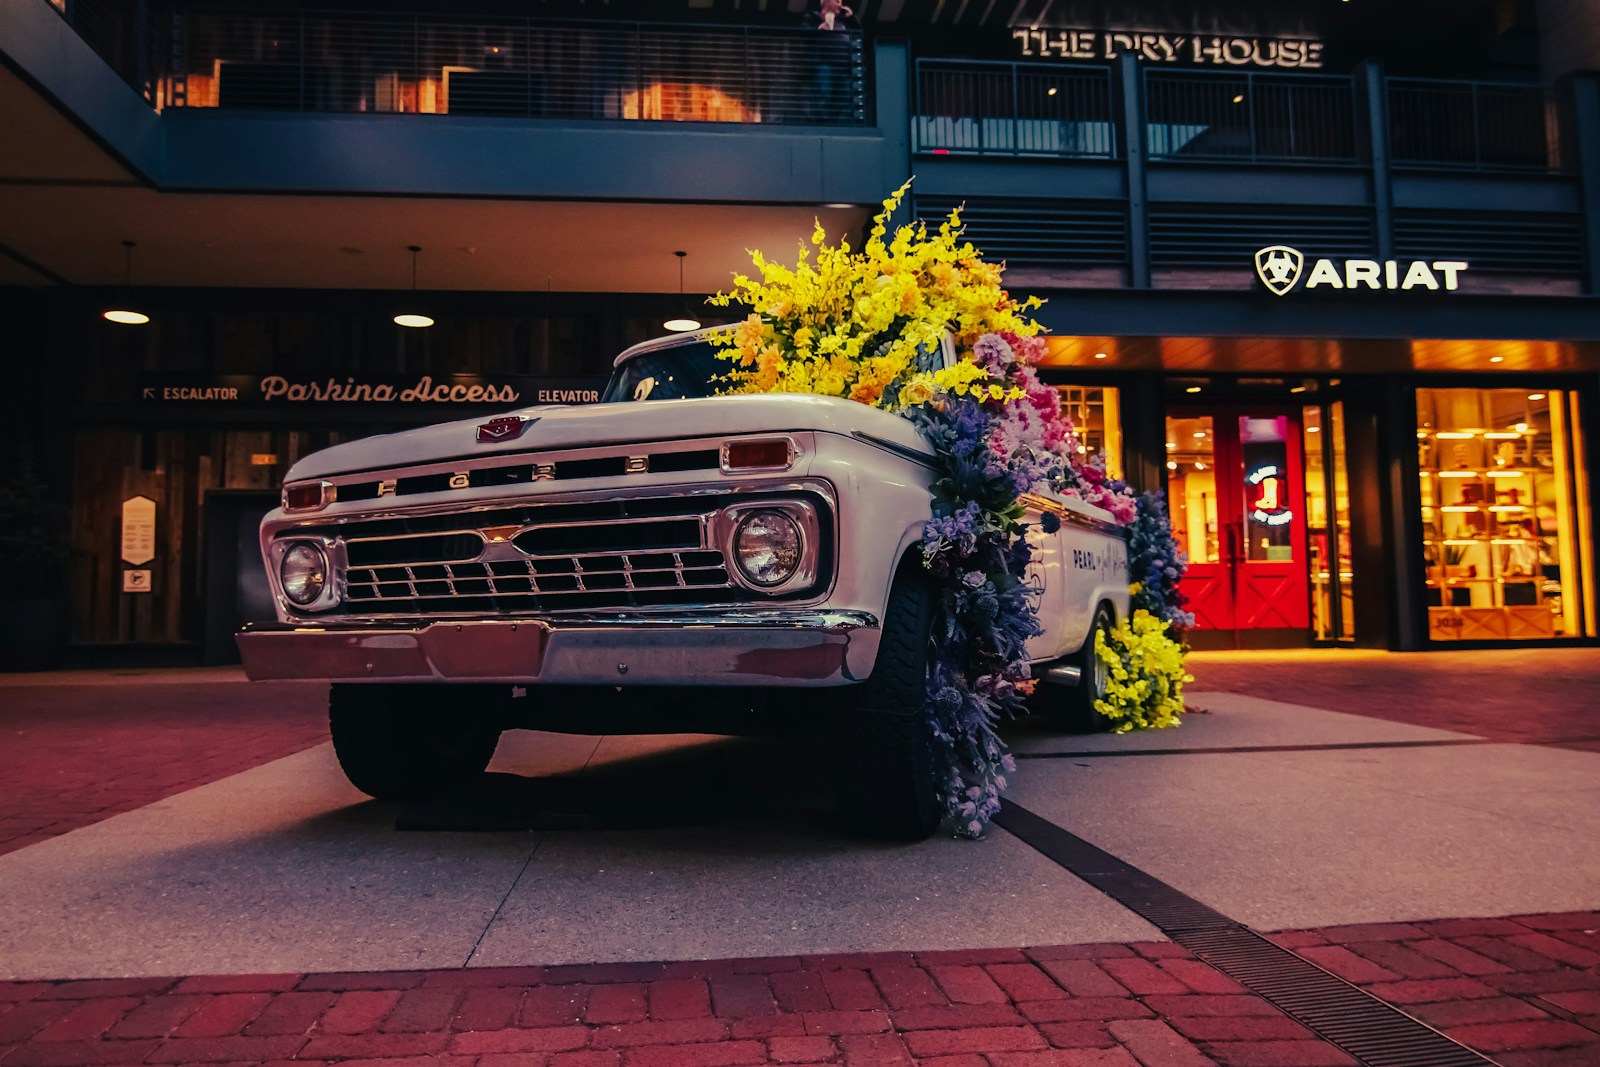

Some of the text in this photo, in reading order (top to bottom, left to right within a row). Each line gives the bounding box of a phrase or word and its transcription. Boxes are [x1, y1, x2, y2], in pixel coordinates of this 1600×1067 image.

[1012, 28, 1325, 69] THE DRY HOUSE
[1305, 258, 1469, 291] ARIAT
[162, 387, 239, 401] ESCALATOR
[400, 375, 520, 403] Access
[538, 389, 599, 403] ELEVATOR
[377, 455, 650, 498] FORD
[1073, 549, 1096, 570] PEARL
